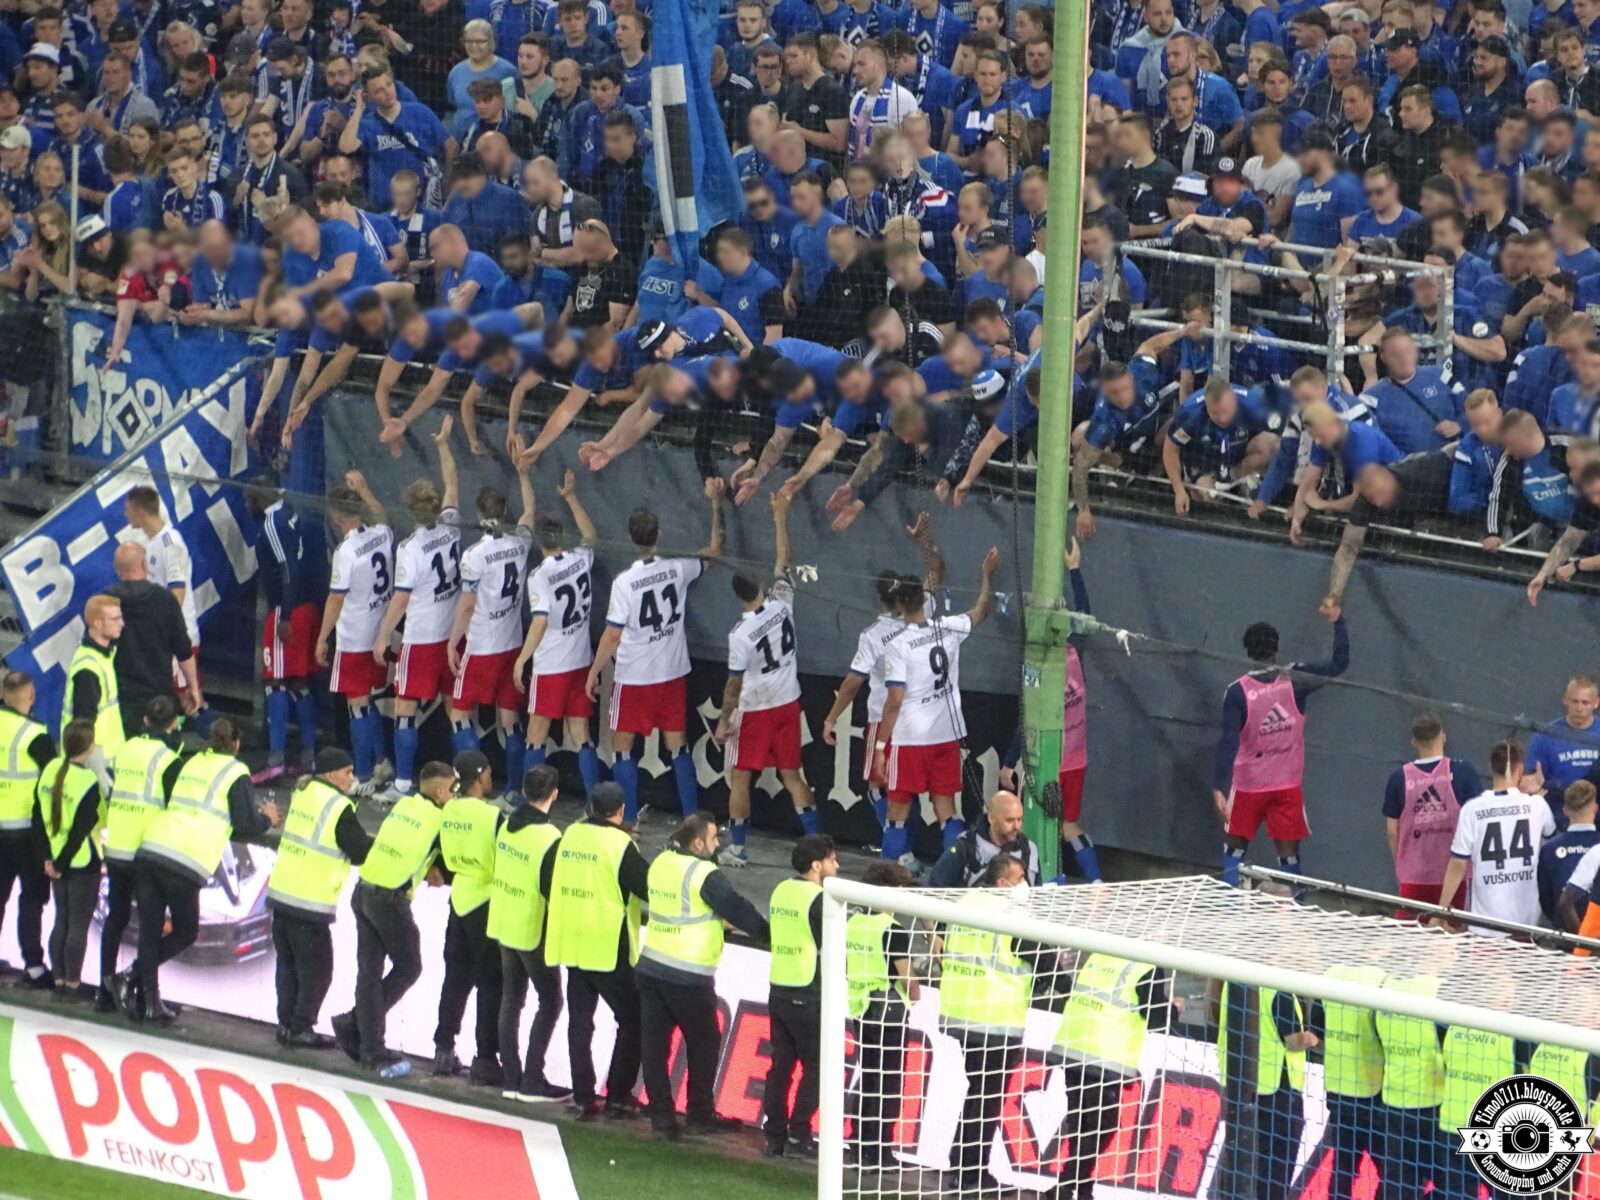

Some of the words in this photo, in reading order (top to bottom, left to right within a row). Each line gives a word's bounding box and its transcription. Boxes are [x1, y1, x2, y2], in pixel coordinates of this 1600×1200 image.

[485, 549, 520, 567] HAMBURGER
[371, 552, 390, 595] 3
[501, 562, 520, 604] 4
[548, 562, 577, 586] HAMBURGER
[630, 571, 668, 591] HAMBURGER
[638, 583, 682, 632] 41
[748, 613, 782, 643] HAMBURGER
[756, 615, 796, 674] 14
[929, 646, 949, 689] 9
[1475, 805, 1521, 821] HAMBURGER
[1522, 804, 1532, 815] SV
[508, 845, 530, 864] POWER
[572, 851, 598, 863] POWER
[1481, 818, 1534, 870] 44
[777, 907, 799, 919] POWER
[1464, 1031, 1497, 1046] POWER
[103, 1138, 216, 1184] FEINKOST
